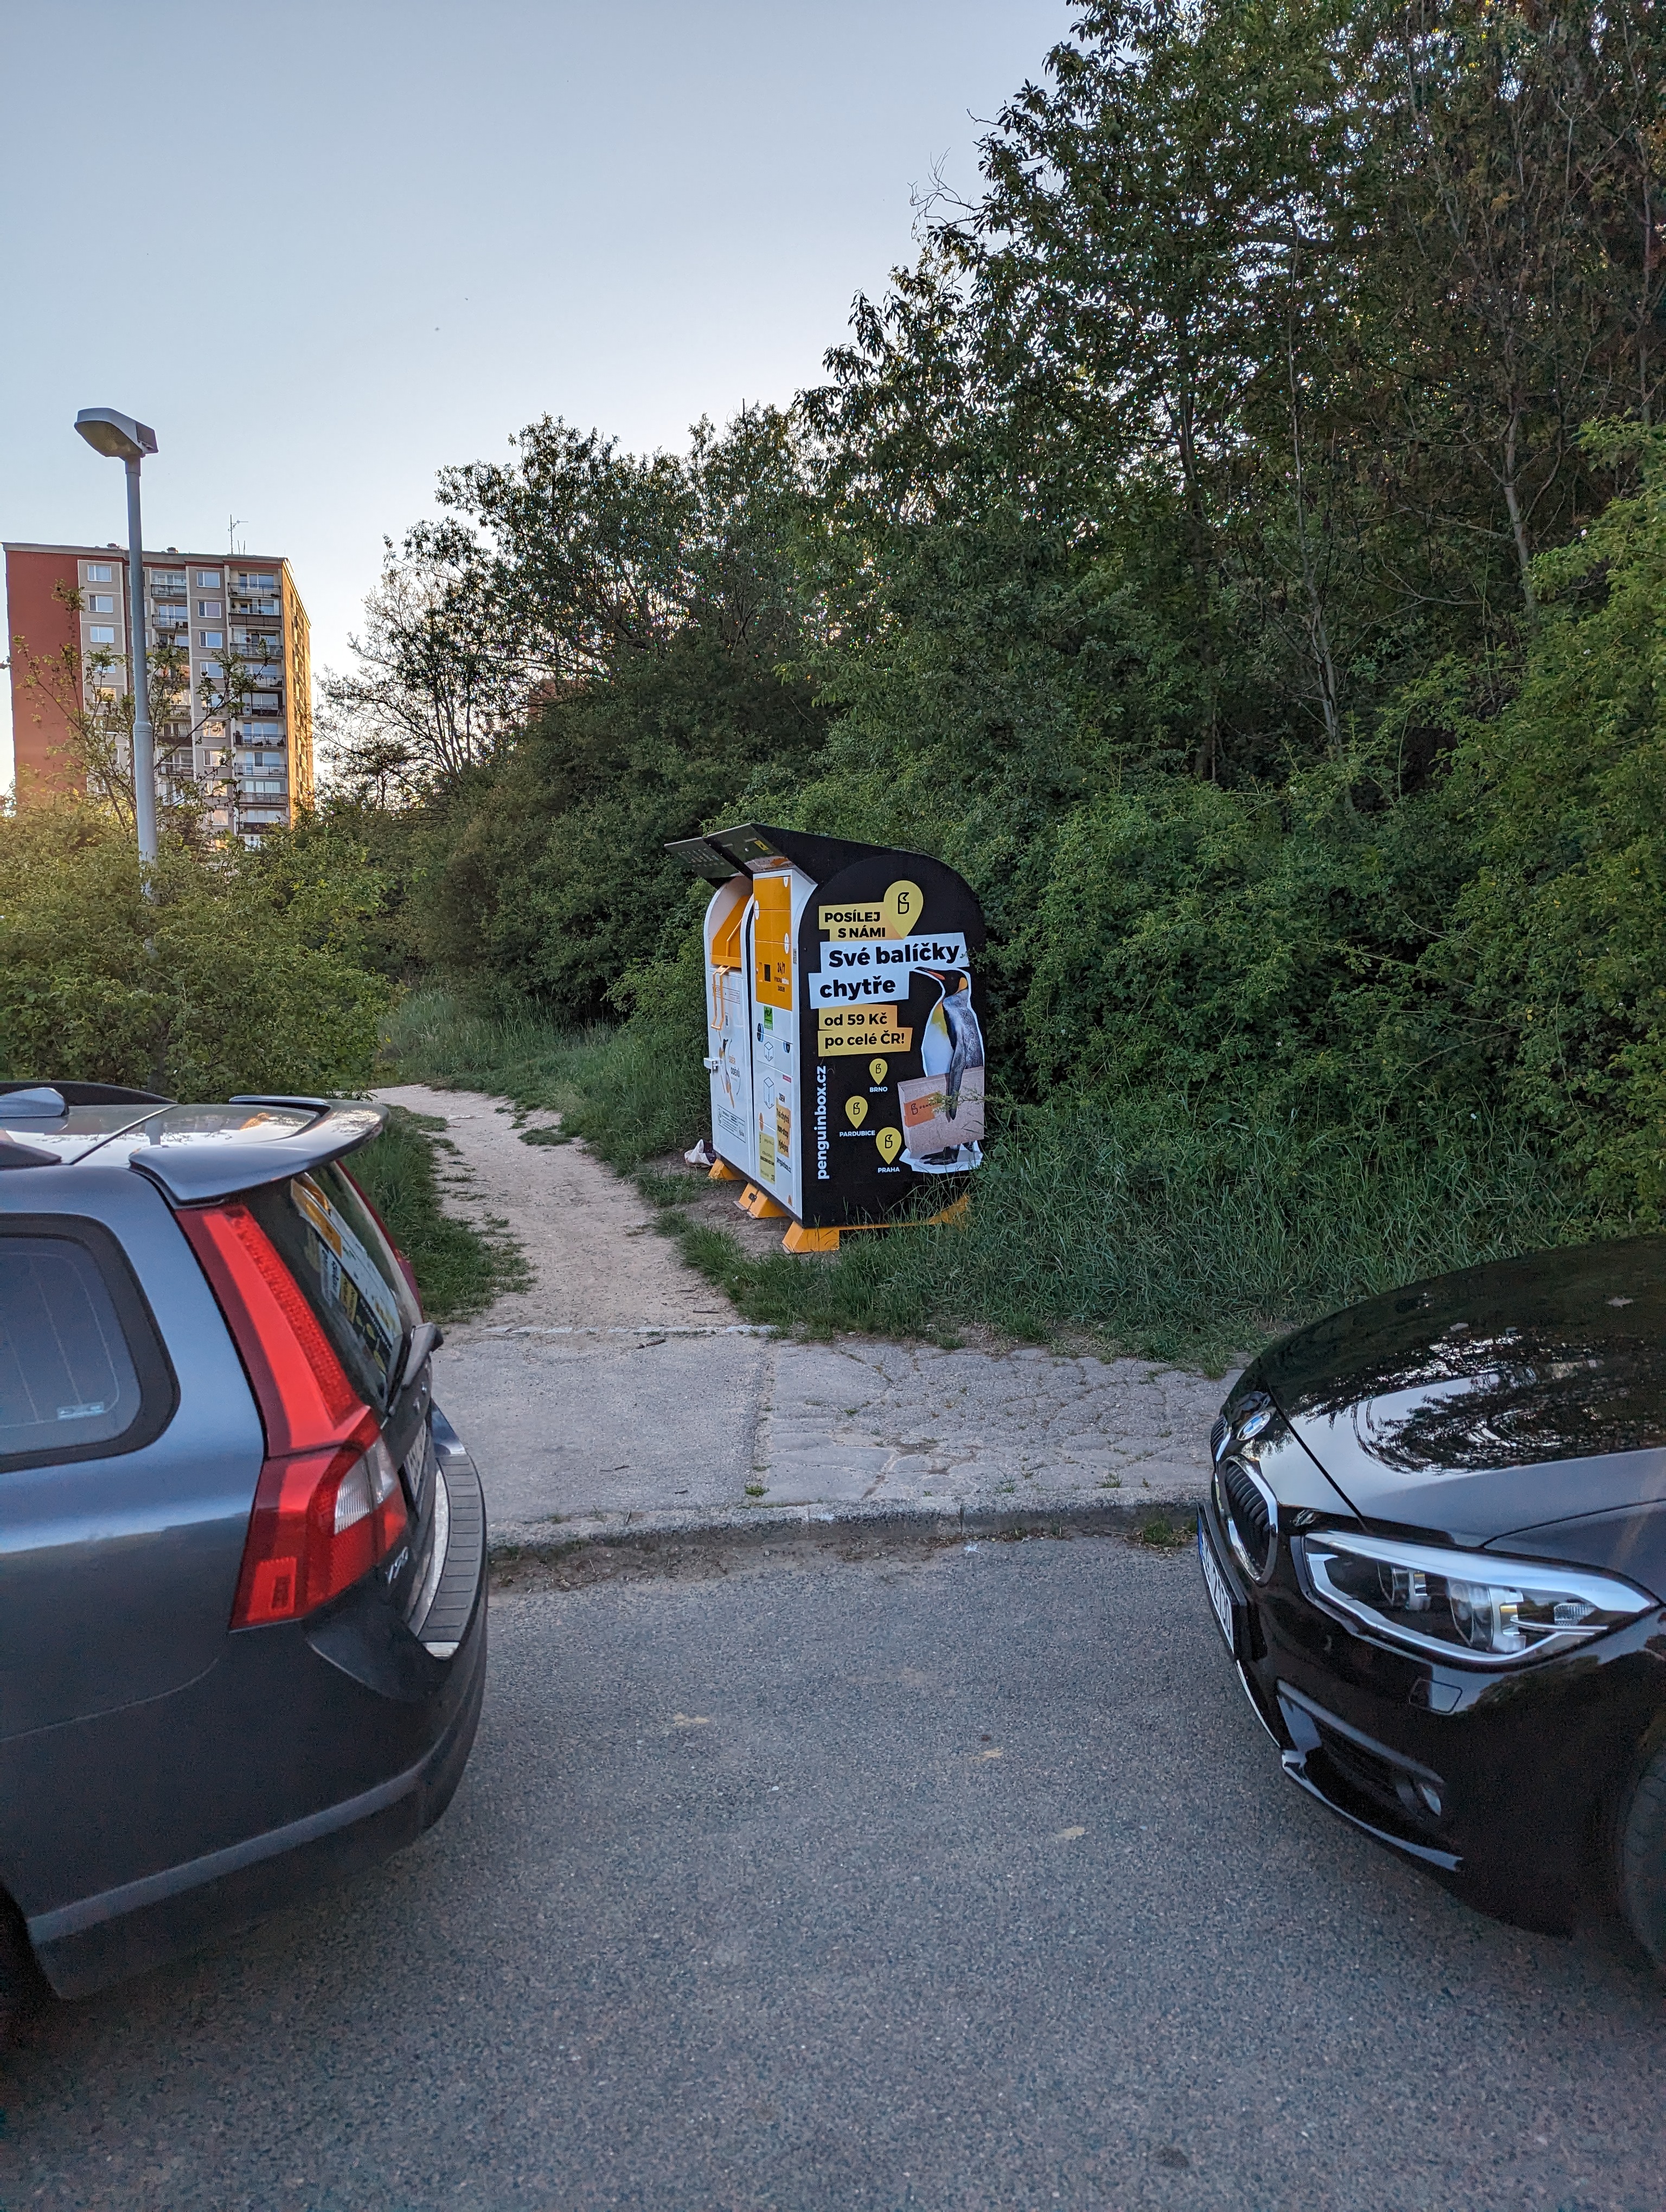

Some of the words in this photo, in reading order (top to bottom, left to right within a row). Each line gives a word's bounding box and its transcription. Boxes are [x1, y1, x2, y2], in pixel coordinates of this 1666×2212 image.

[824, 909, 880, 923] POSÍLEJ
[838, 928, 846, 938] S
[849, 925, 886, 938] NÁMI
[829, 947, 870, 968] Své
[876, 942, 960, 964] balíčky
[819, 975, 896, 1001] chytře
[824, 1014, 843, 1026] od
[847, 1014, 864, 1025] 59
[869, 1012, 888, 1025] Kč
[825, 1037, 844, 1049] po
[847, 1033, 877, 1045] celé
[880, 1030, 905, 1044] ČR!
[814, 1065, 830, 1180] penguinbox.cz
